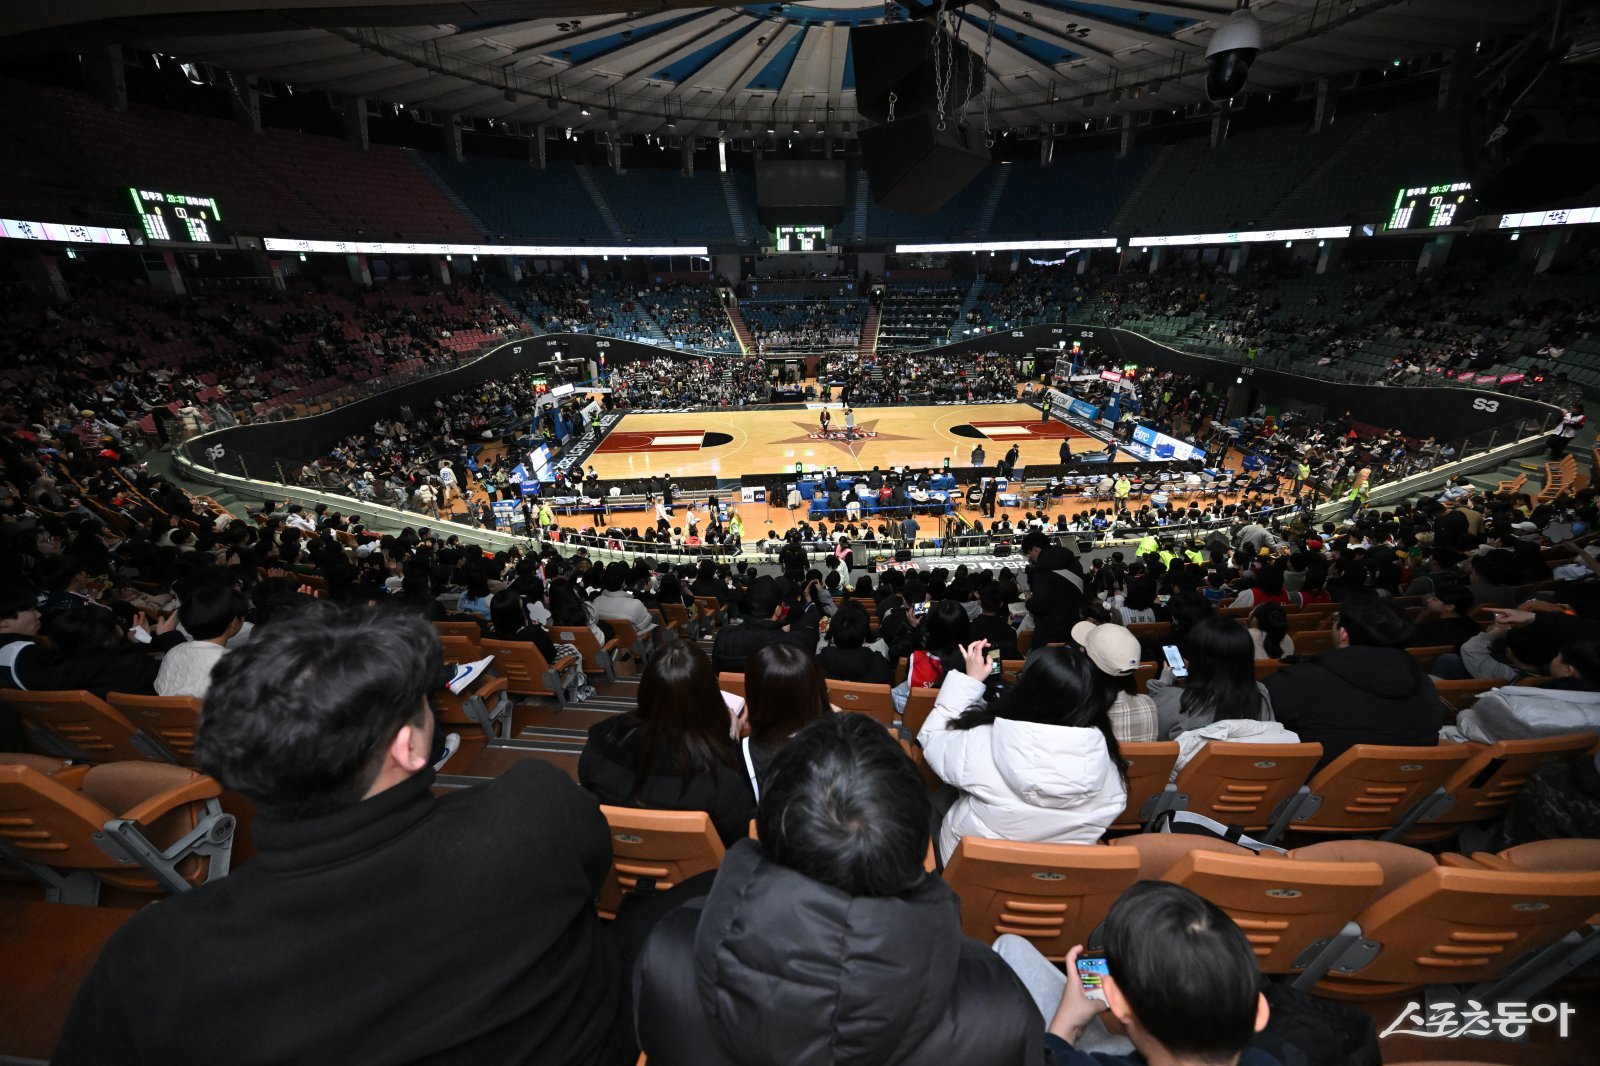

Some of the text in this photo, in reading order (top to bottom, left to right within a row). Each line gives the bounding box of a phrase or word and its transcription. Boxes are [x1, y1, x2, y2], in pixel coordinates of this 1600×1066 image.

[512, 346, 522, 354] S7
[1125, 369, 1135, 377] 24
[535, 384, 546, 392] 24
[1472, 398, 1500, 413] S3
